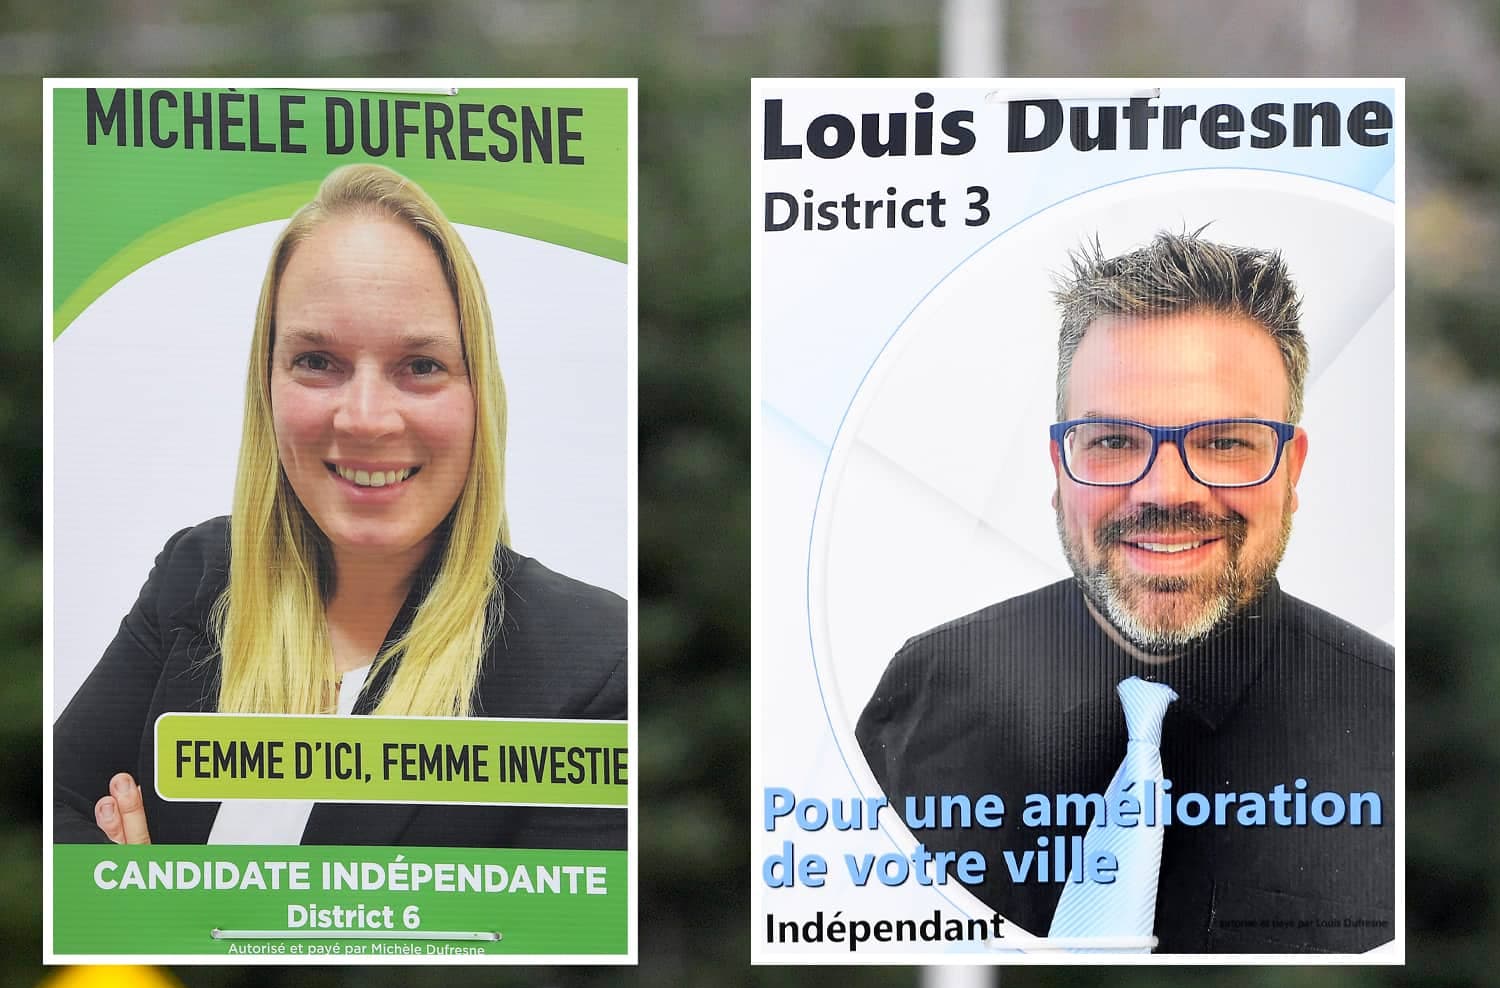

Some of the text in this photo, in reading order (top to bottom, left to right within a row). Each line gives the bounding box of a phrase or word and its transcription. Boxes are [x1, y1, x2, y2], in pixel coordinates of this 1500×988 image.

[86, 88, 585, 165] MICHÈLE DUFRESNE
[764, 92, 1393, 160] Louis Dufresne
[764, 185, 990, 232] District 3
[176, 740, 285, 779] FEMME
[383, 743, 489, 782] FEMME
[499, 745, 629, 785] INVESTIE
[764, 778, 1384, 831] Pour une amélioration
[93, 854, 608, 895] CANDIDATE INDÉPENDANTE
[762, 835, 1119, 888] de votre ville
[287, 903, 421, 929] District 6
[766, 910, 1005, 951] Indépendant
[228, 942, 485, 955] Autorisé et payé par Michèle Dufresne
